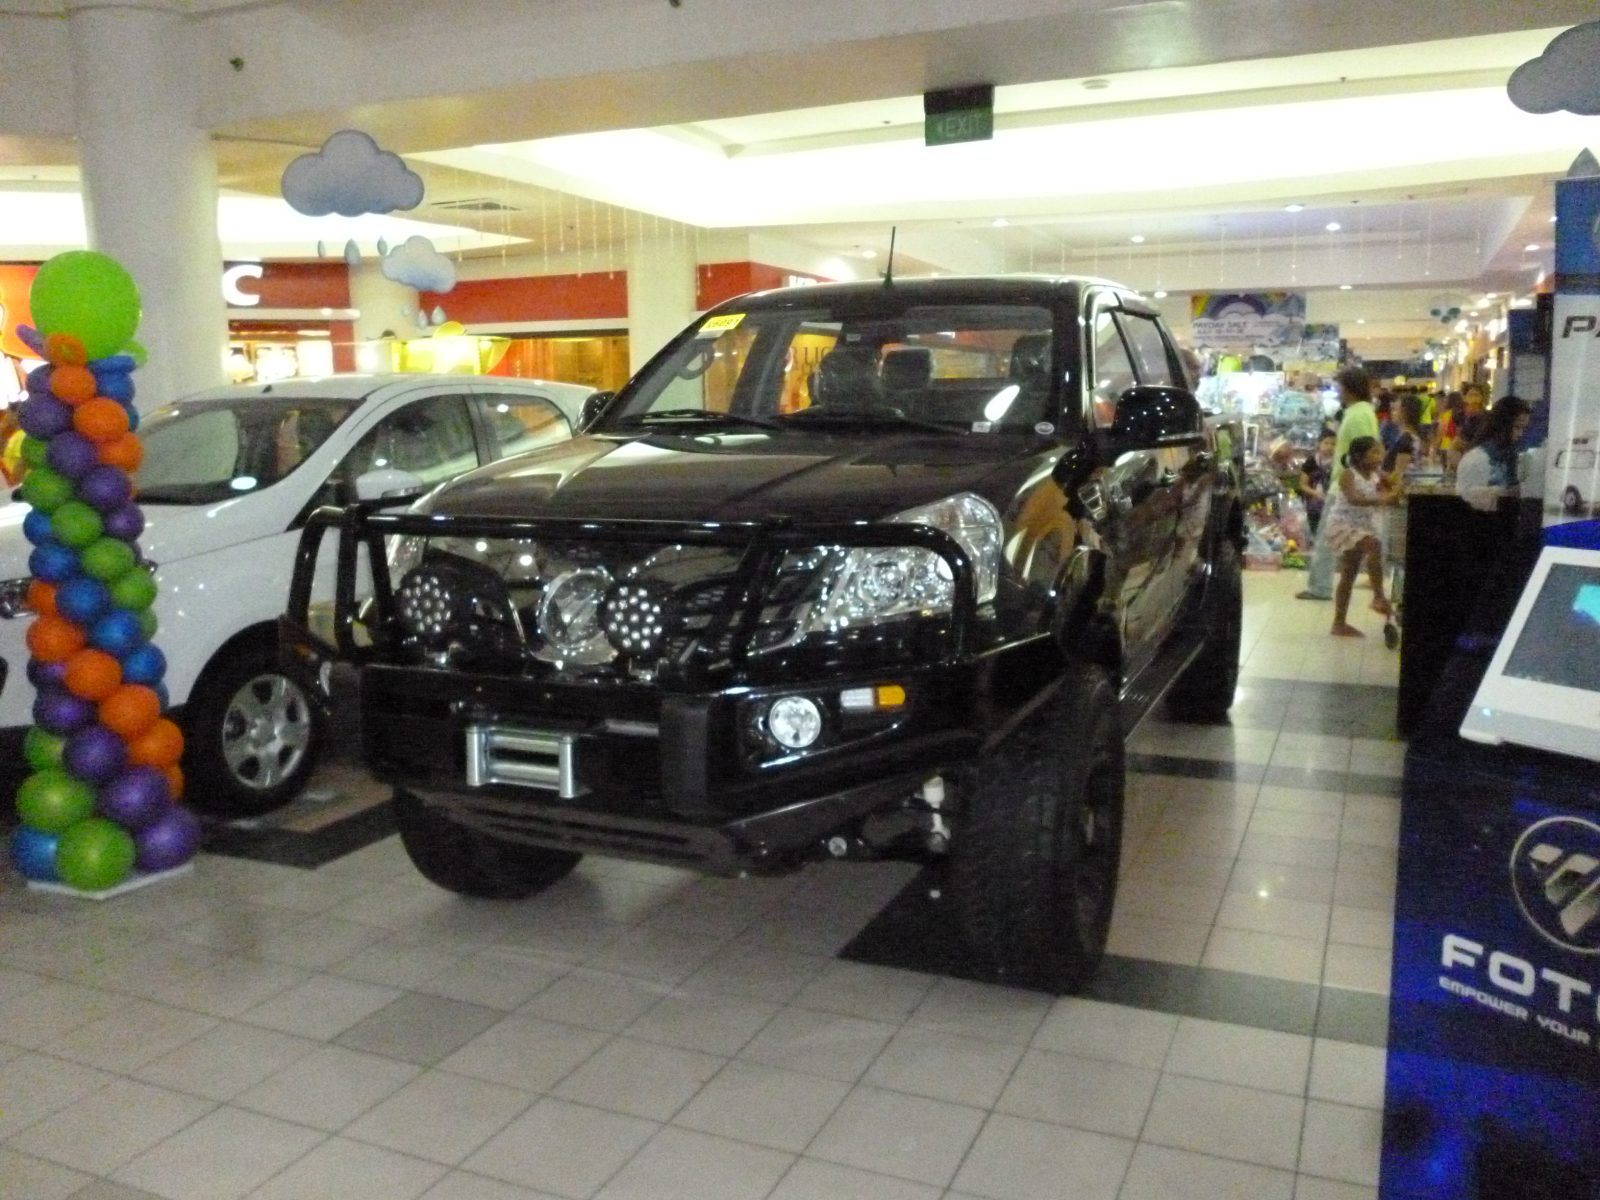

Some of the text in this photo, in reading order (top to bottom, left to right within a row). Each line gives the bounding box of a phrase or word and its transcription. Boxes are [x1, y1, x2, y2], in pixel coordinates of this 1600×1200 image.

[945, 113, 982, 137] EXIT
[1562, 315, 1600, 338] P
[1442, 934, 1600, 1024] FOT
[1439, 976, 1591, 1045] EMPOWER YOUR
